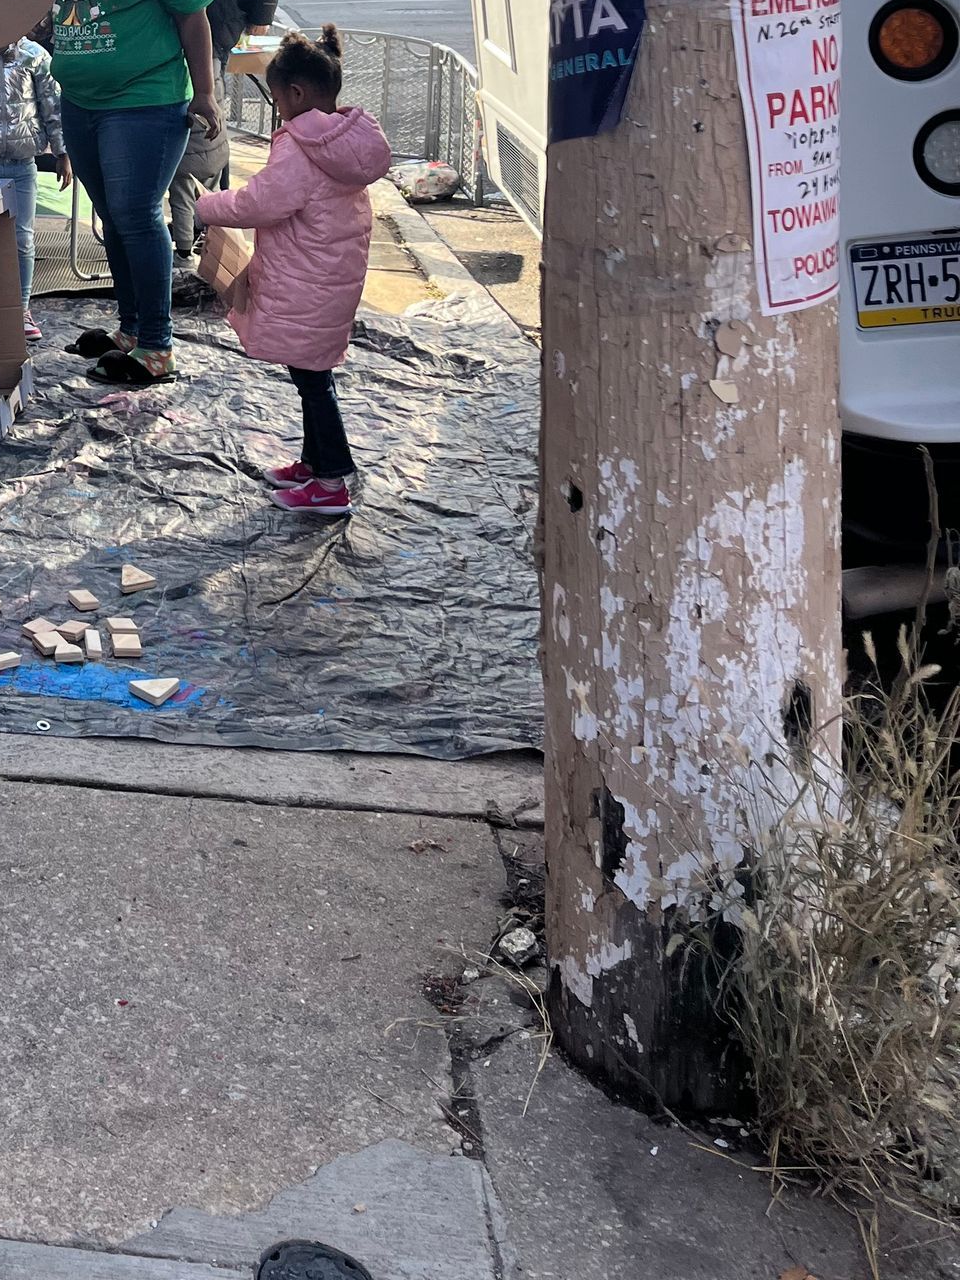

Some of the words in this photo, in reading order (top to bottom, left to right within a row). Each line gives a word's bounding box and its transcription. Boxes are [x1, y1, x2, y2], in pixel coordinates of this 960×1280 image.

[757, 26, 773, 43] N.
[812, 34, 838, 75] NO
[767, 159, 803, 177] FROM
[797, 177, 818, 199] 24
